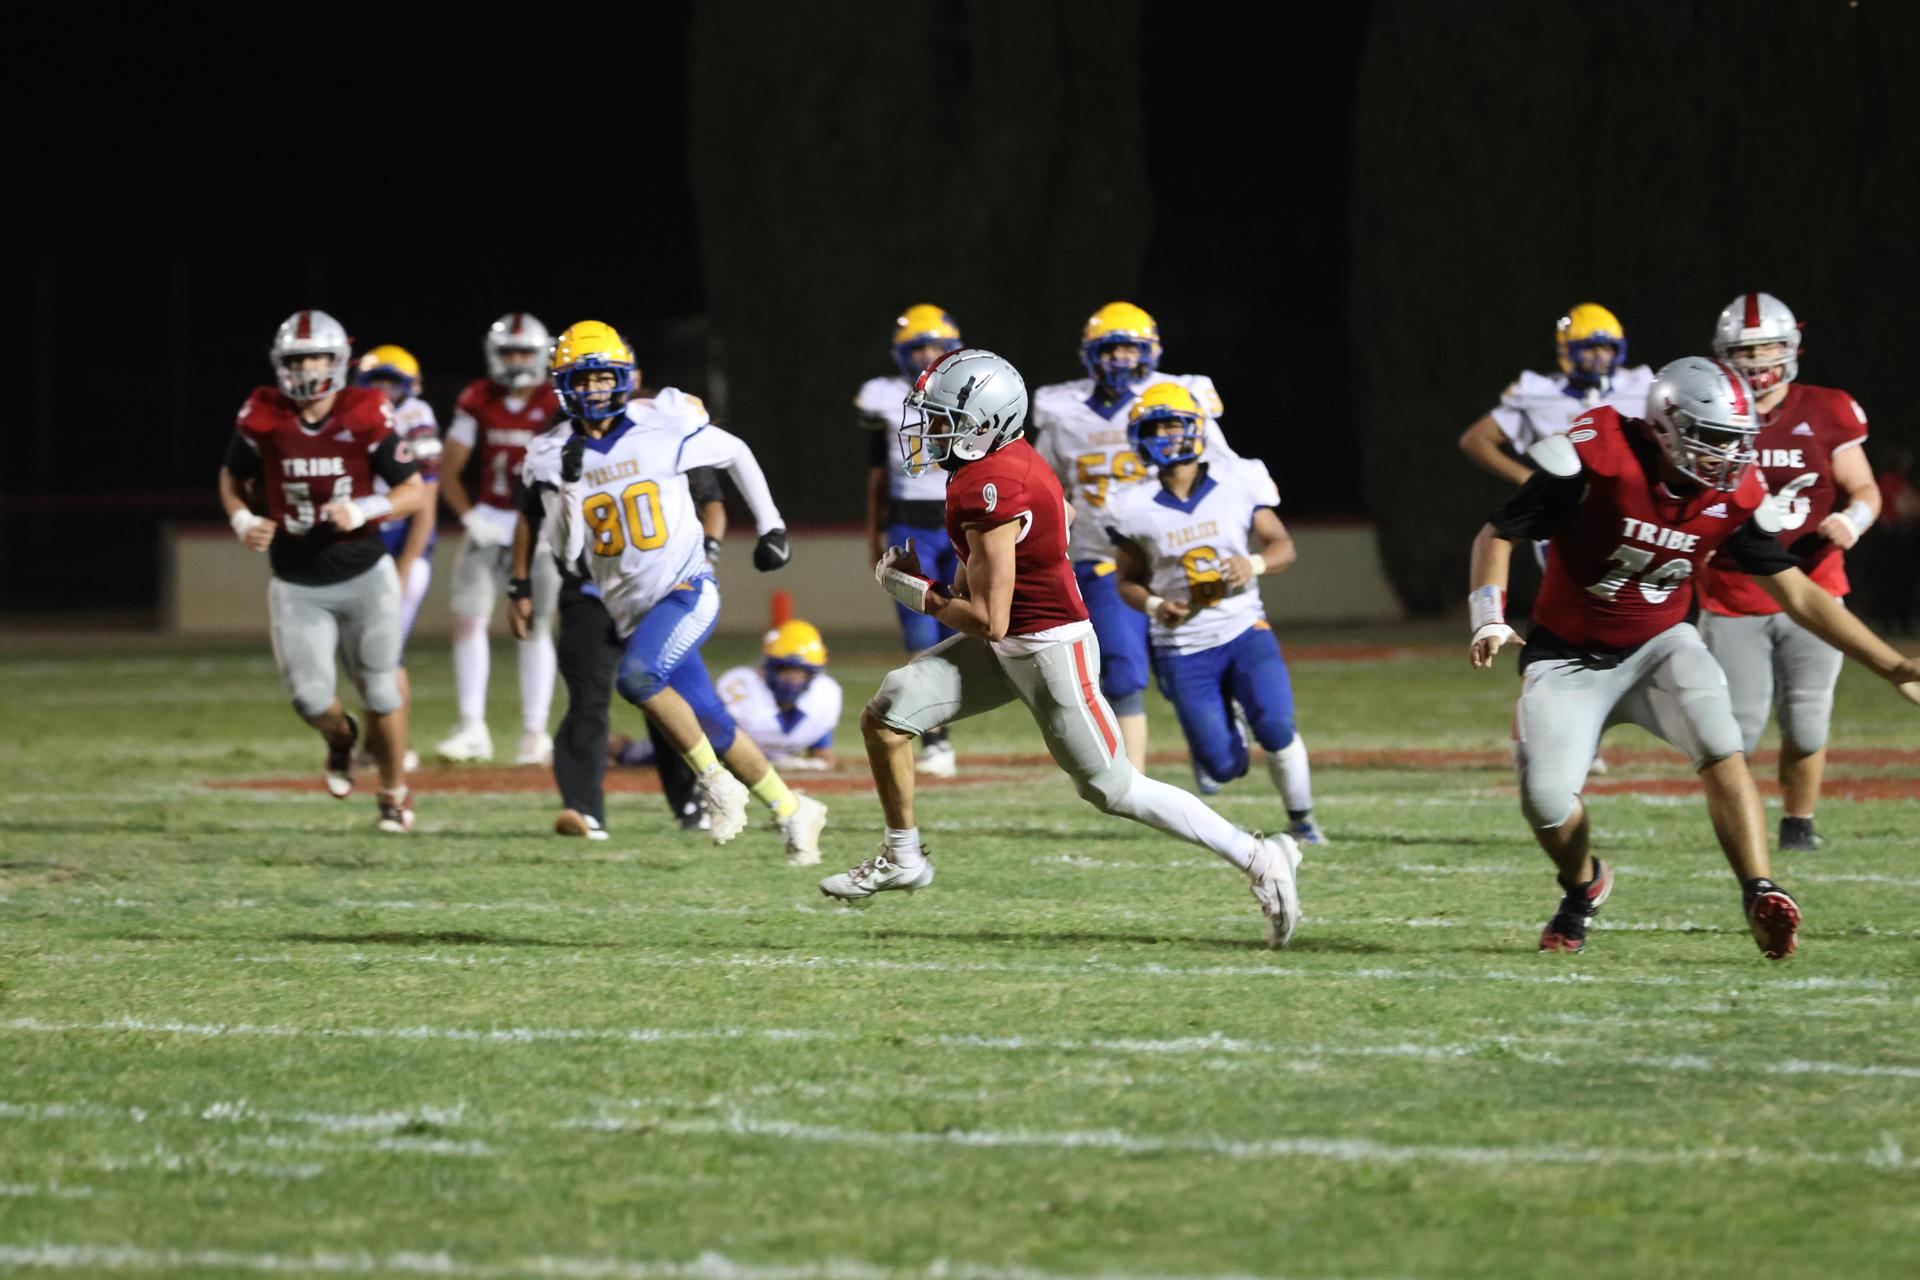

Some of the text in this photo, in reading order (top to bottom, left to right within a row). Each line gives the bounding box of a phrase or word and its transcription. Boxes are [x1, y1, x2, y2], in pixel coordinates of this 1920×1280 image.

[282, 456, 346, 477] TRIBE
[583, 479, 669, 557] 80
[982, 482, 998, 513] 9
[1777, 472, 1819, 531] 6
[1622, 517, 1701, 553] TRIBE
[1183, 545, 1227, 609] 6
[1584, 544, 1694, 605] 70
